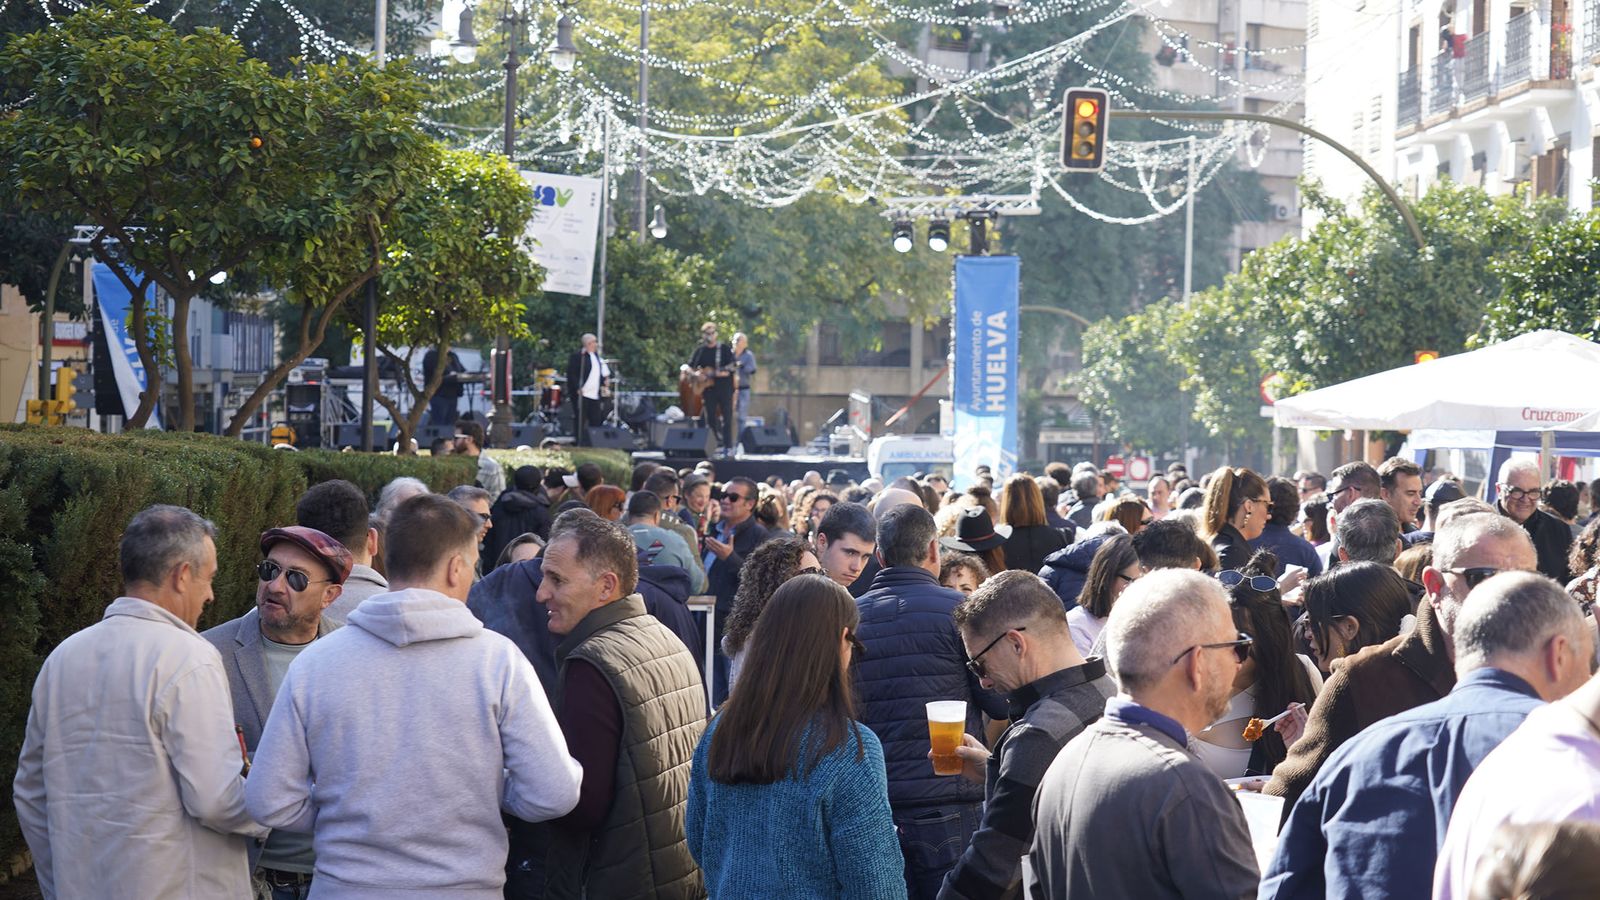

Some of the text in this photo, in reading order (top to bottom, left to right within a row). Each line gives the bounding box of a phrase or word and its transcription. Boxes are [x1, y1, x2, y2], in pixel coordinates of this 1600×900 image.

[970, 310, 982, 411] Ayuntamiento de
[986, 310, 1007, 412] HUELVA
[1521, 406, 1589, 422] Cruzcamp
